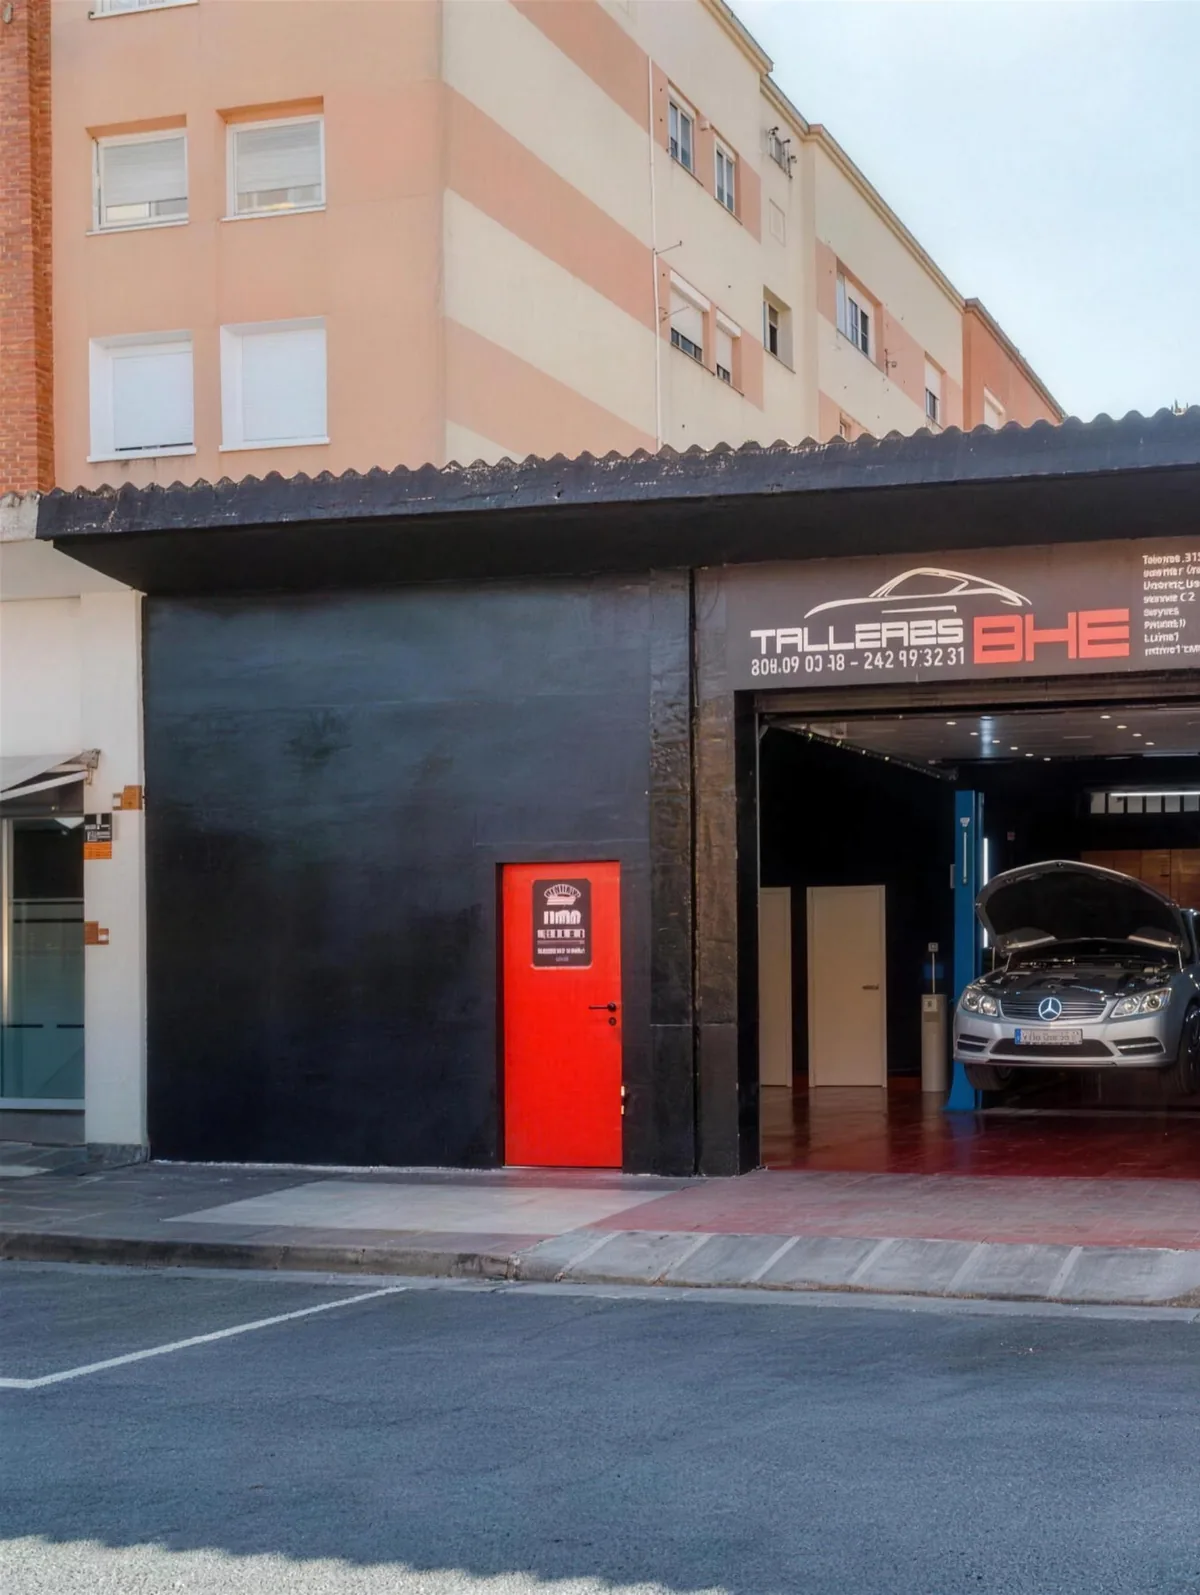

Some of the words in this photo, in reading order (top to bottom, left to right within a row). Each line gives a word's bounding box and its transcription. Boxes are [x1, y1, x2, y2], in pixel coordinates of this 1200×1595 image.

[973, 608, 1130, 664] BHE
[864, 651, 894, 669] 242
[947, 647, 965, 666] 31
